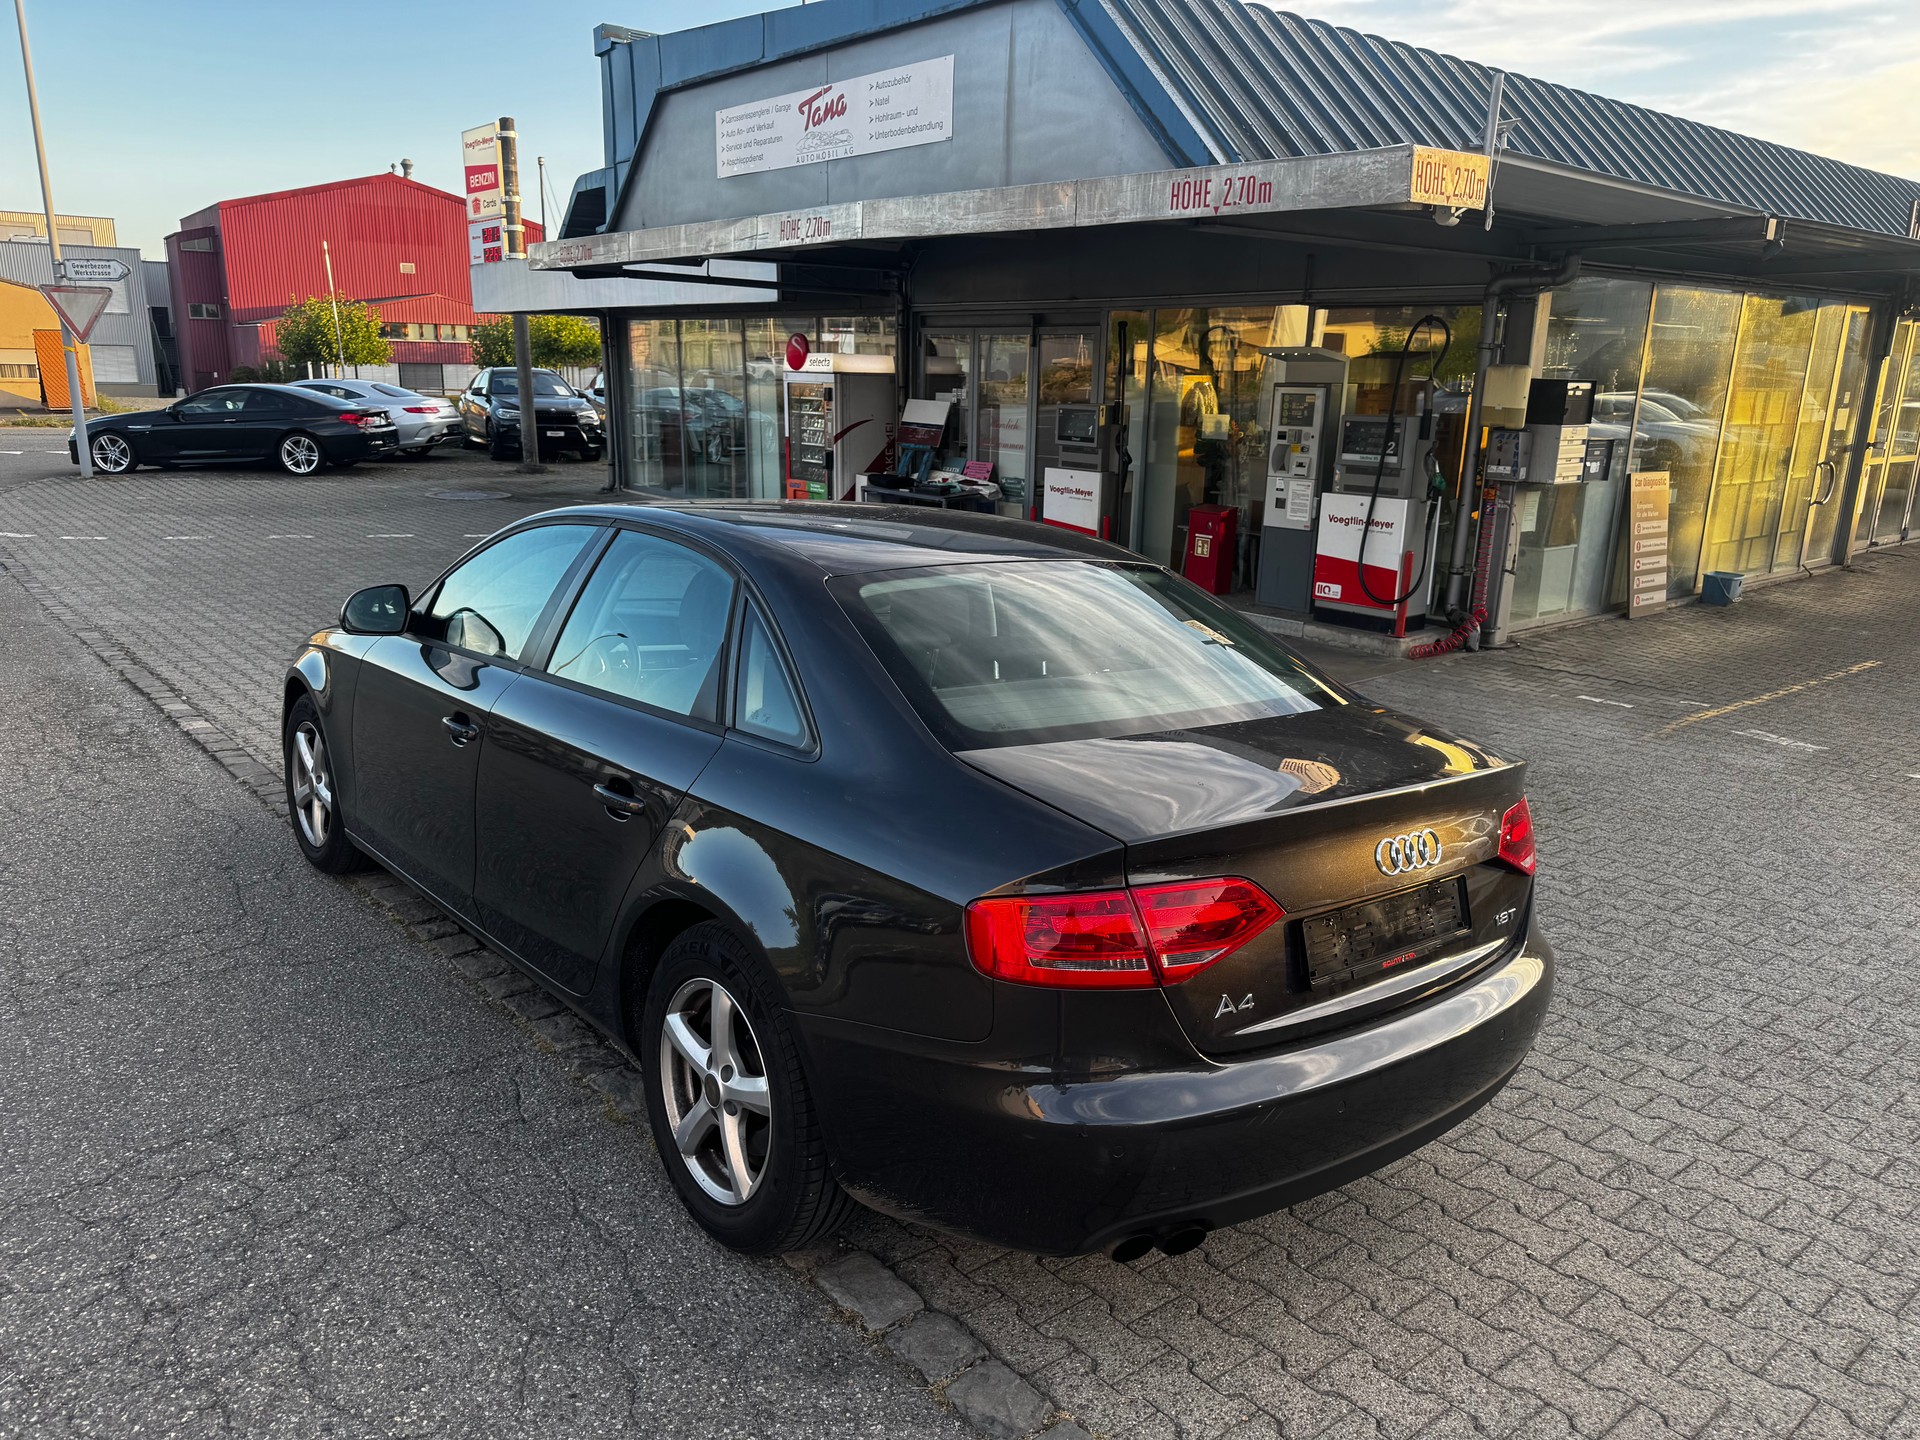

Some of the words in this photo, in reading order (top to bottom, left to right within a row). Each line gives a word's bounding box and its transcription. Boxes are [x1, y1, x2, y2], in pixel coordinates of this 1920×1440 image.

[875, 74, 912, 90] Autozubehör
[875, 95, 890, 107] Natel
[775, 104, 791, 113] Garage
[798, 85, 847, 132] Tana
[906, 106, 919, 117] und
[726, 130, 736, 138] Auto
[746, 124, 756, 134] und
[756, 120, 775, 131] Verkauf
[875, 121, 944, 140] Unterbodenbehandlung
[726, 144, 742, 153] Service
[743, 139, 753, 149] und
[753, 136, 783, 147] Reparaturen
[727, 154, 764, 166] Abschleppdienst
[796, 149, 838, 164] AUTOMOBIL
[844, 147, 854, 156] AG
[469, 171, 495, 188] BENZIN
[1415, 154, 1447, 195] HÖHE
[1170, 175, 1212, 211] HÖHE
[483, 199, 497, 209] Cards
[780, 216, 801, 241] HÖHE
[71, 262, 111, 270] Gewerbezone
[809, 358, 831, 367] selecta
[1088, 425, 1093, 436] 1
[1386, 441, 1396, 454] 2
[1643, 476, 1667, 489] Diagnostic
[1050, 485, 1094, 498] Voegtlin-Meyer
[1214, 993, 1255, 1019] A4
